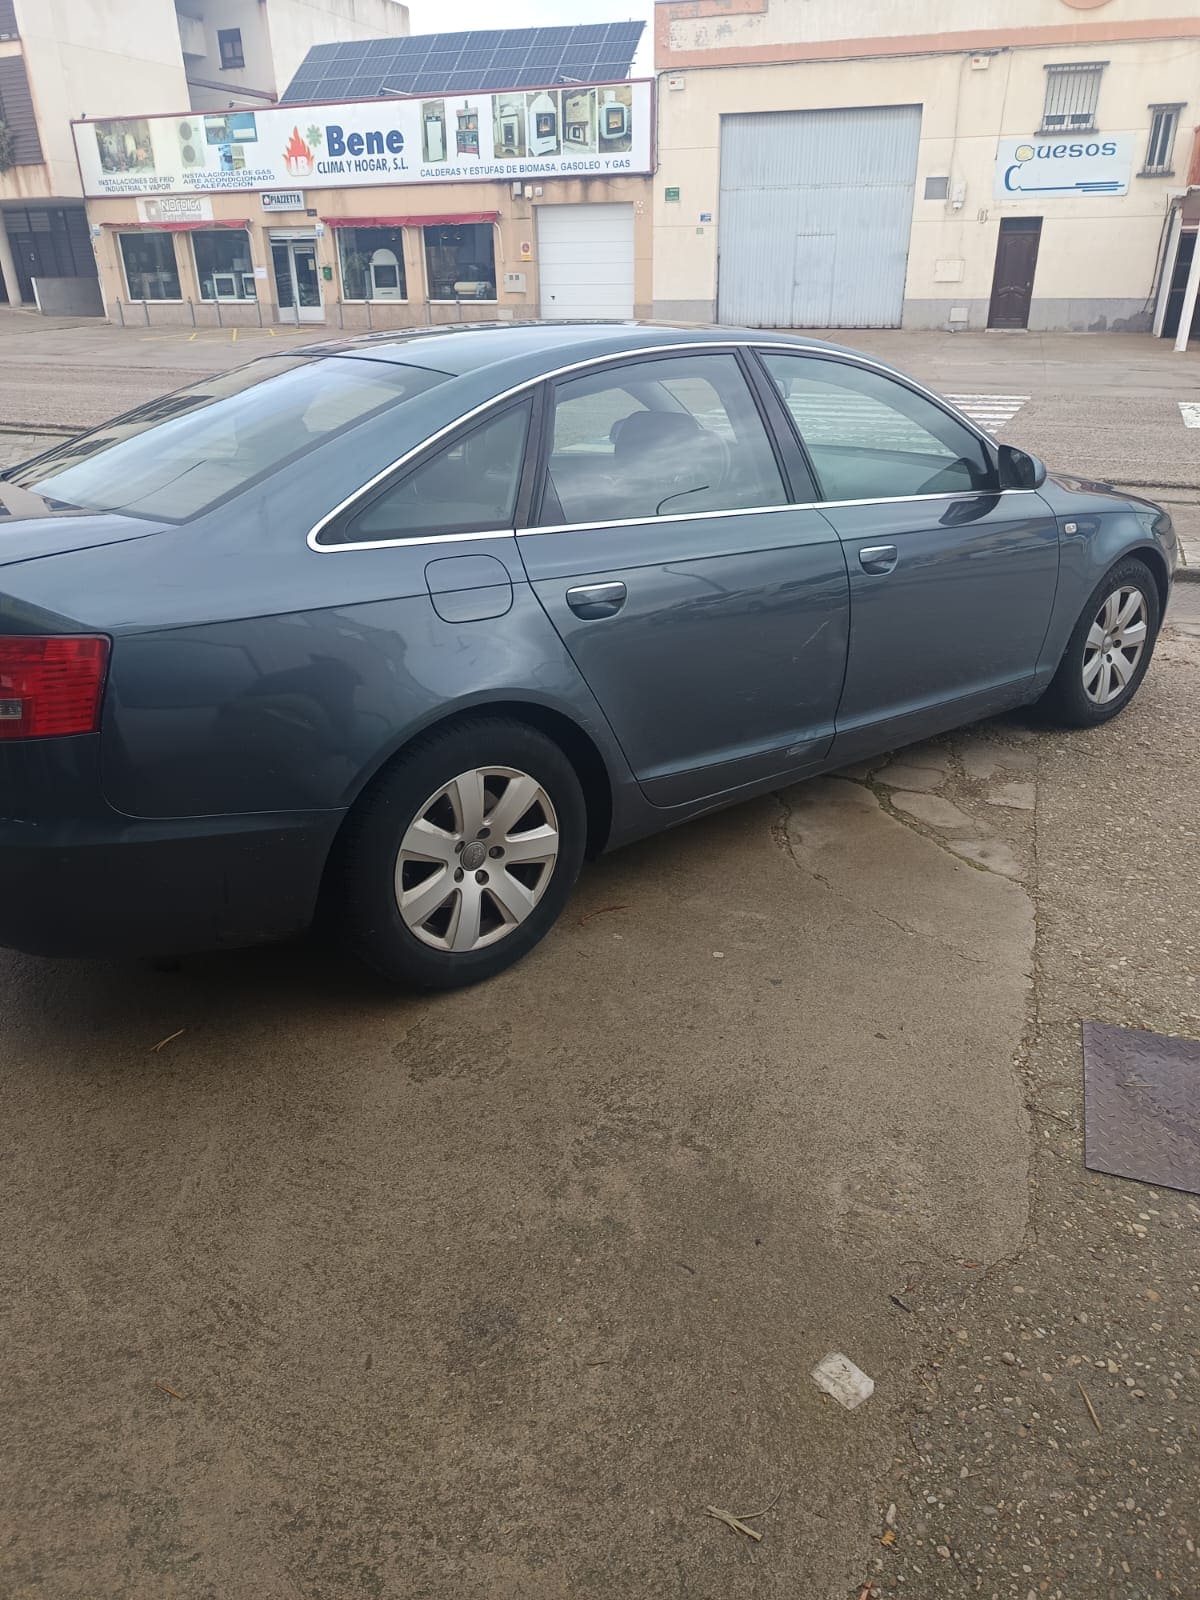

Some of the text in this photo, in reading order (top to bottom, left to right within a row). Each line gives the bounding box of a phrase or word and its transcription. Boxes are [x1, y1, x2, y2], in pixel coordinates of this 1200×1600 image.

[326, 125, 404, 157] Bene
[317, 157, 409, 174] CLIMA Y HOGAR, S.L.
[420, 167, 461, 177] CALDERAS
[463, 167, 468, 175] Y
[469, 165, 504, 176] ESTUFAS
[506, 164, 518, 173] DE
[604, 161, 610, 169] Y
[612, 159, 630, 169] GAS
[182, 170, 241, 179] INSTALACIONES
[204, 174, 275, 183] ACONDICIONADO
[98, 177, 148, 186] INSTALACIONES
[105, 184, 142, 193] INDUSTRIAL
[149, 183, 171, 191] VAPOR
[271, 194, 301, 205] PIAZZETTA
